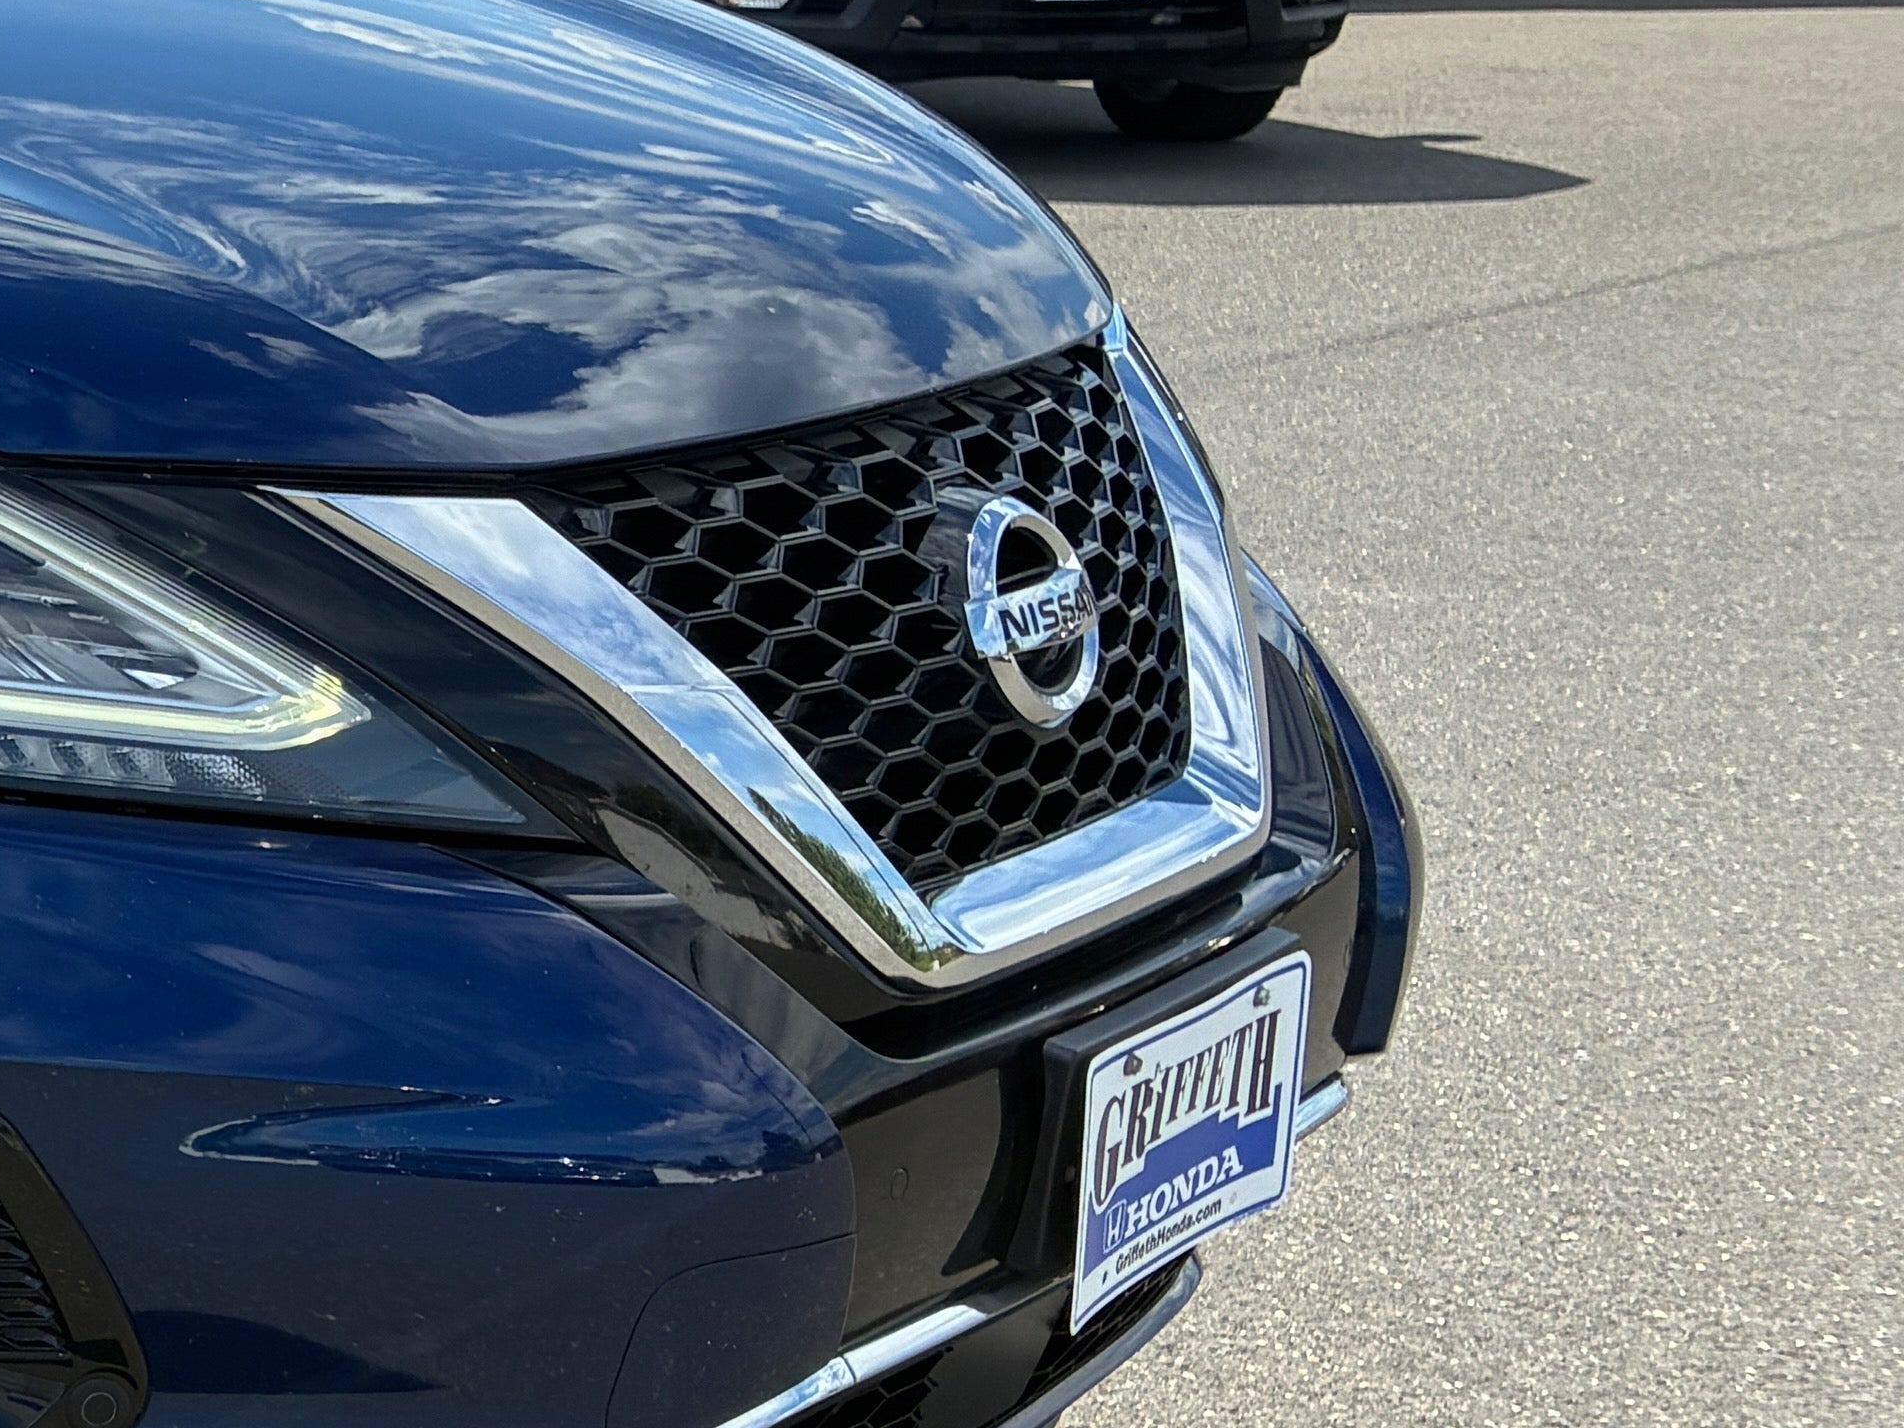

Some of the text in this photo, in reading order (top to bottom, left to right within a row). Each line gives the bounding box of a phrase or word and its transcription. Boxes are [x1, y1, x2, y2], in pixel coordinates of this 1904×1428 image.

[1094, 1008, 1282, 1207] GRIFFETH
[1115, 1198, 1222, 1275] GriffethHonda.com
[1124, 1145, 1244, 1240] HONDA
